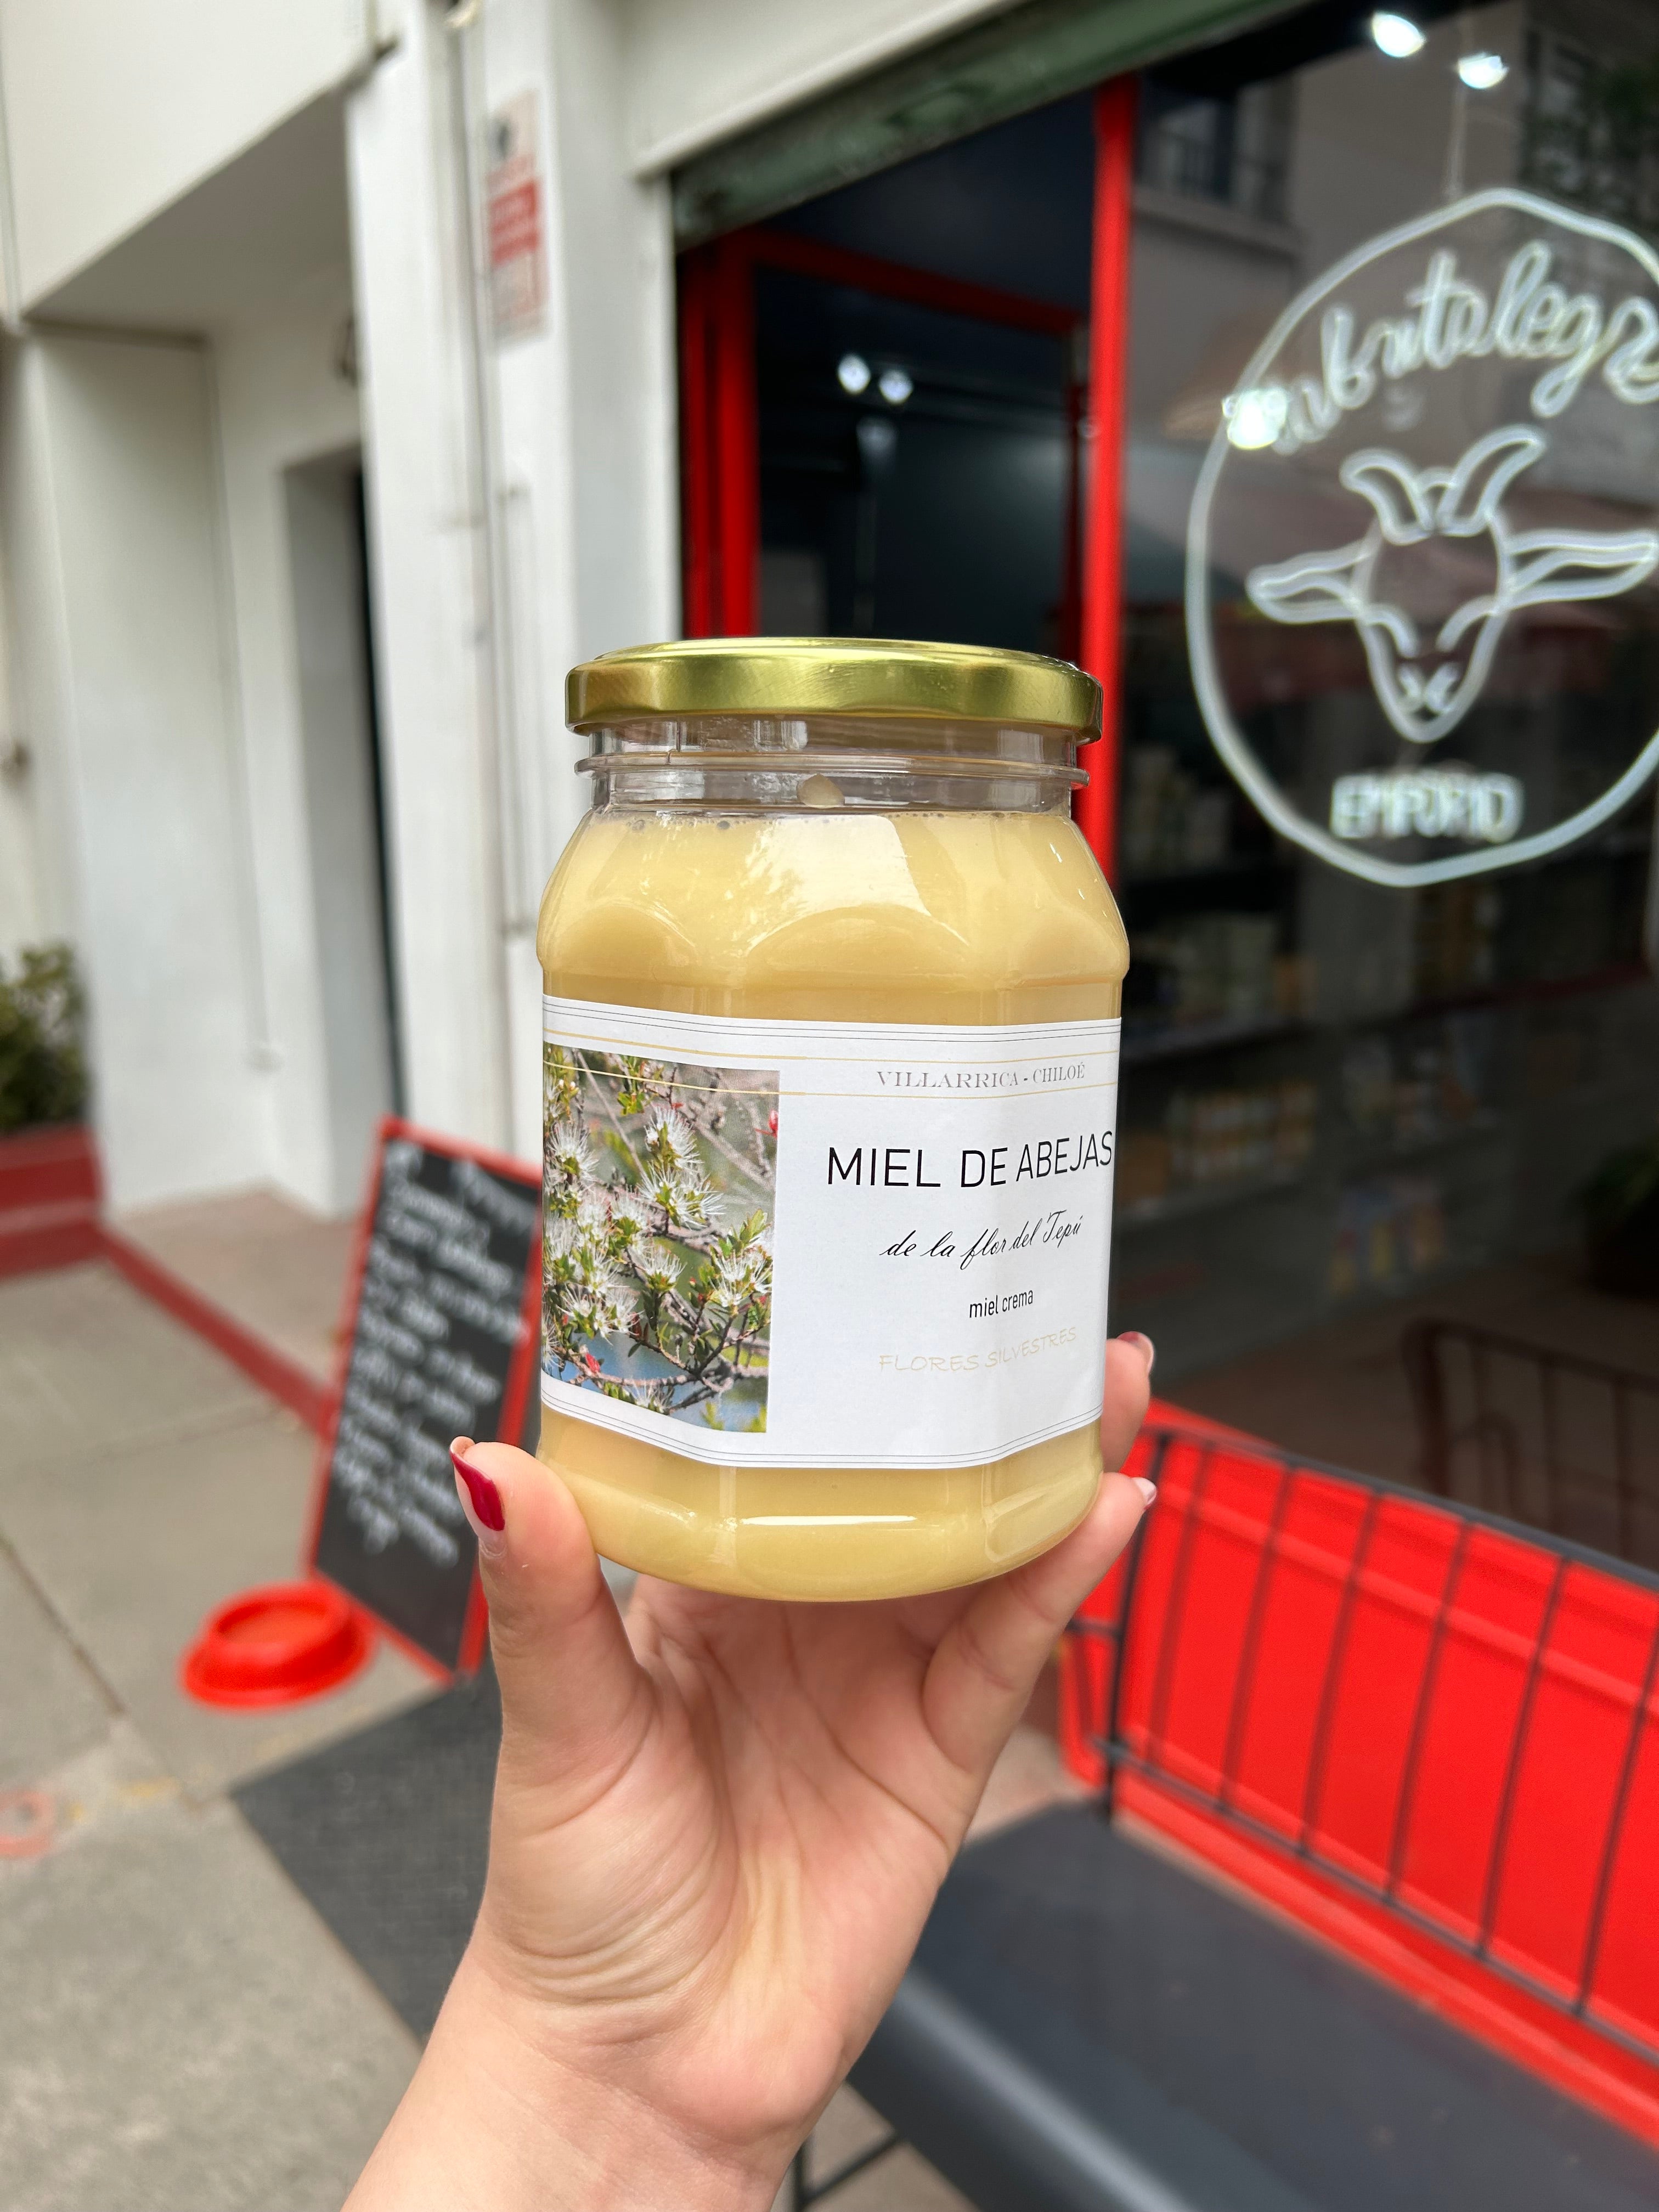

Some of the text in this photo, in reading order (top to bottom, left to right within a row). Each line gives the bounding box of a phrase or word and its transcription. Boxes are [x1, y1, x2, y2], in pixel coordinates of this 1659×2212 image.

[878, 1071, 1019, 1088] VILLARRICA
[1032, 1062, 1085, 1084] CHILOÉ
[827, 1131, 1113, 1188] MIEL DE ABEJAS
[879, 1209, 1083, 1270] de la flor del Tepú
[969, 1289, 1034, 1318] miel crema
[879, 1327, 1077, 1372] FLORES SILVESTRES
